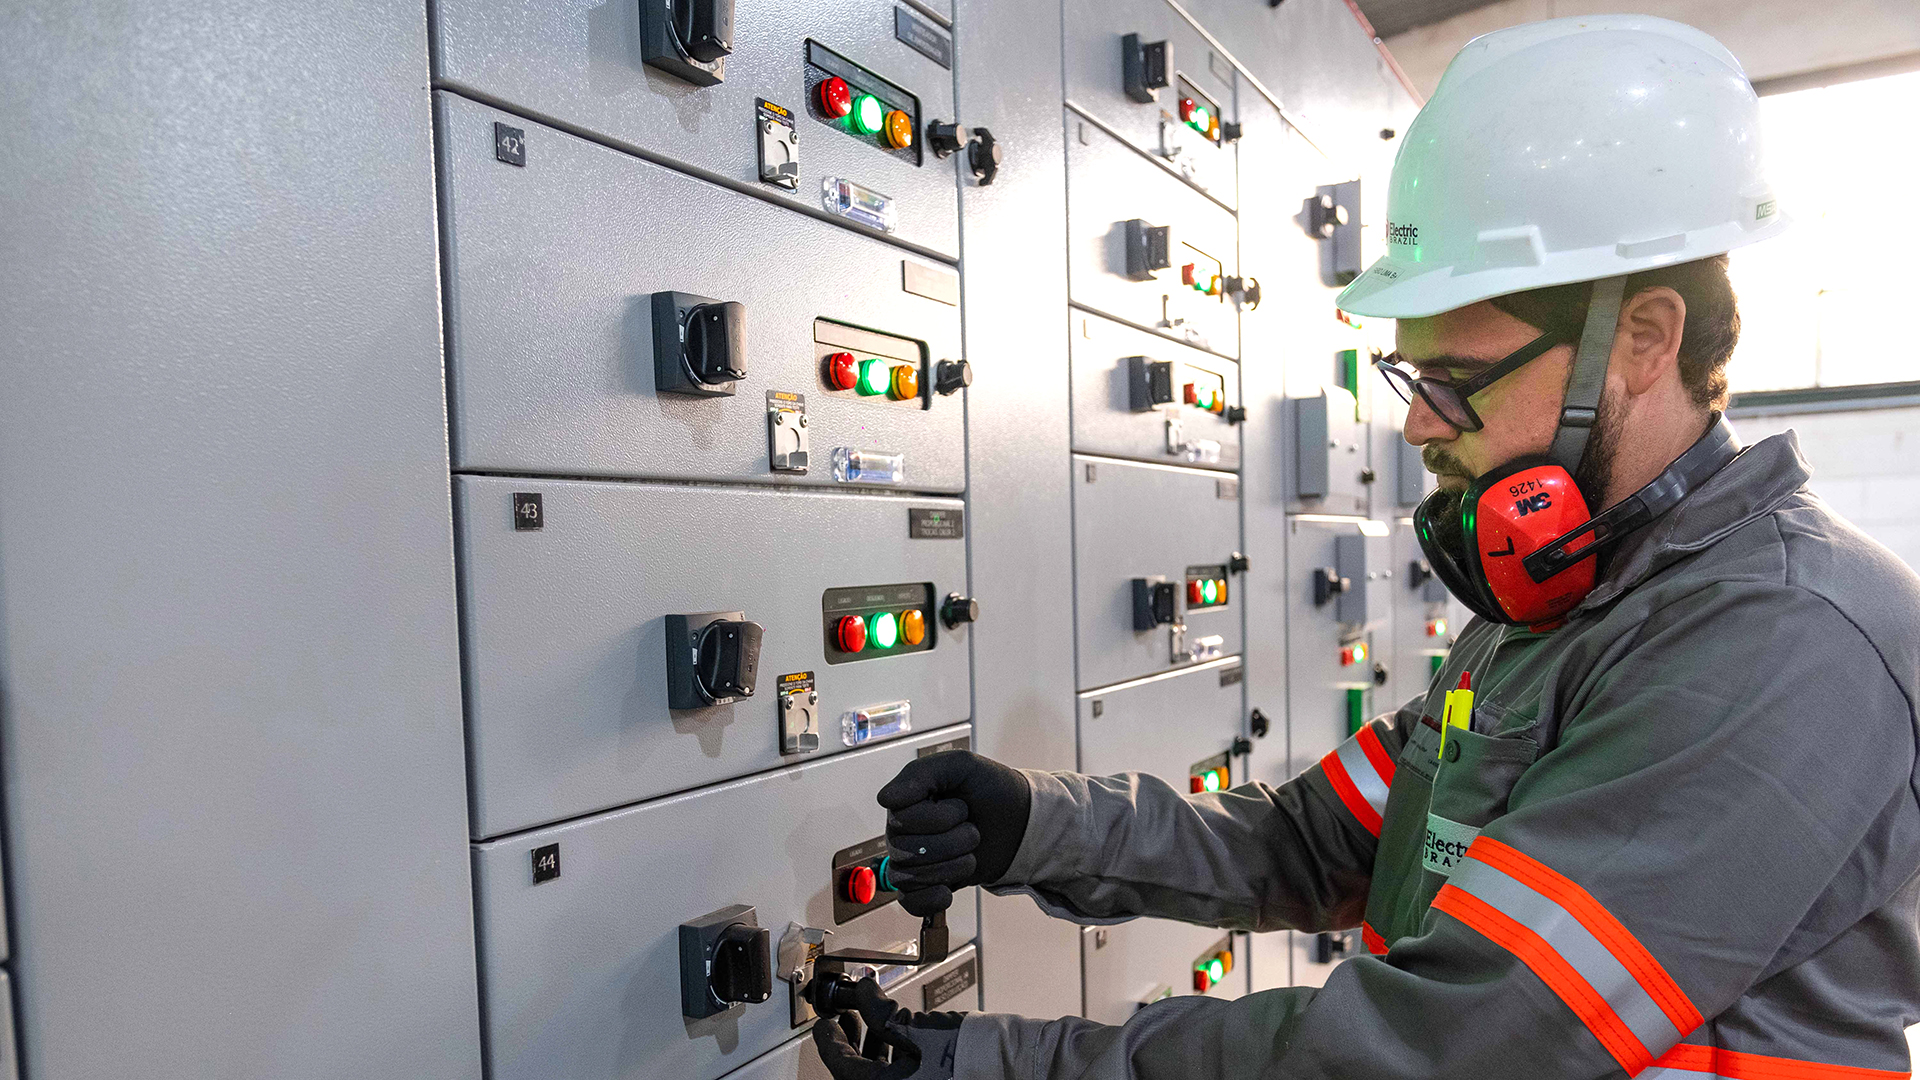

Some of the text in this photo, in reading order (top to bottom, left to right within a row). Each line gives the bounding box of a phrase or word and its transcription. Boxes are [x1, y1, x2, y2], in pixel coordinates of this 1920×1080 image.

[763, 101, 788, 117] ATENÇÃO
[501, 136, 520, 156] 42
[1389, 222, 1419, 238] Electric
[774, 391, 798, 402] ATENÇÃO
[1509, 477, 1544, 498] 1426
[520, 502, 538, 519] 43
[1515, 492, 1552, 517] 3M
[784, 671, 808, 683] ATENÇÃO
[538, 853, 556, 872] 44
